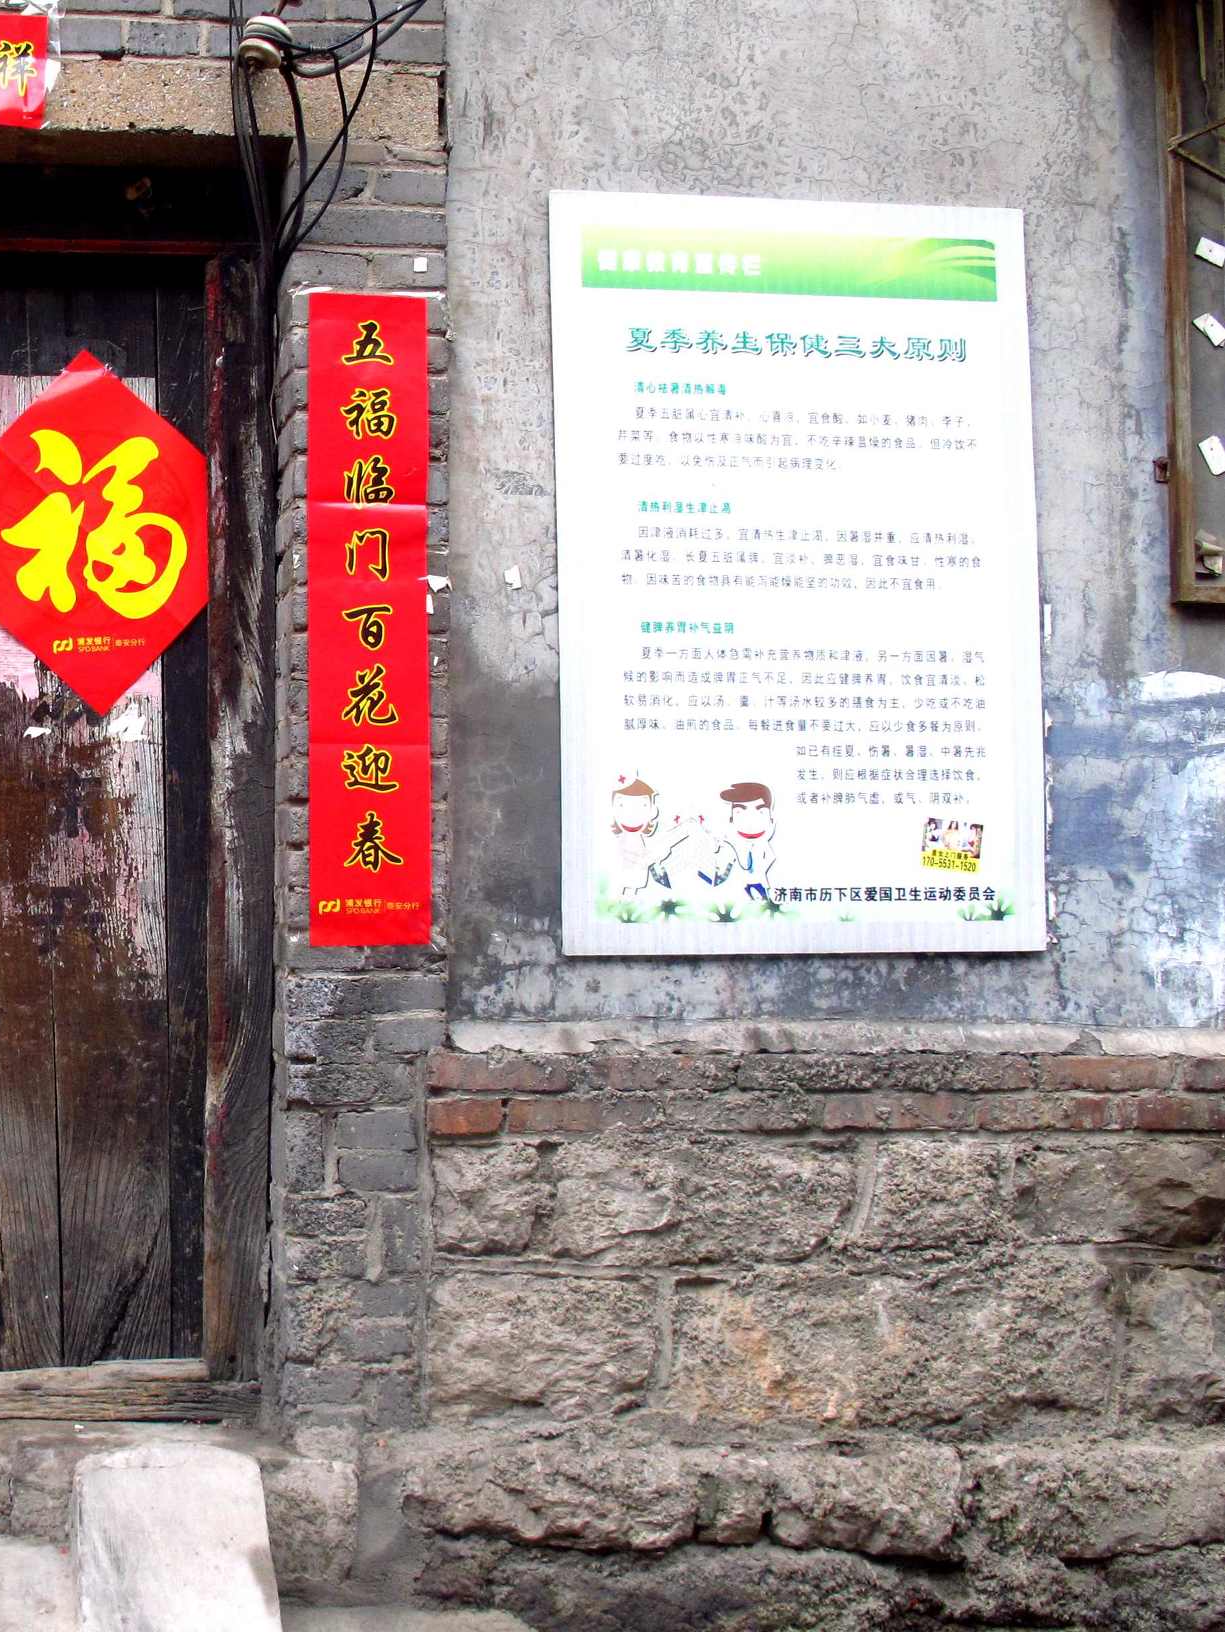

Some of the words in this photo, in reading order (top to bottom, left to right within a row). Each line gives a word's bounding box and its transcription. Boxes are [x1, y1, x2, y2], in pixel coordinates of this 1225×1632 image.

[625, 326, 969, 362] 夏季养生保健三大原则
[0, 429, 189, 620] 福
[341, 320, 404, 872] 五福临门百花迎春
[796, 768, 981, 782] 发生则应根据症状合理选择饮食
[922, 856, 976, 872] 170-5531-1520
[774, 886, 996, 902] 济南市历下区爱国卫生运动委员会
